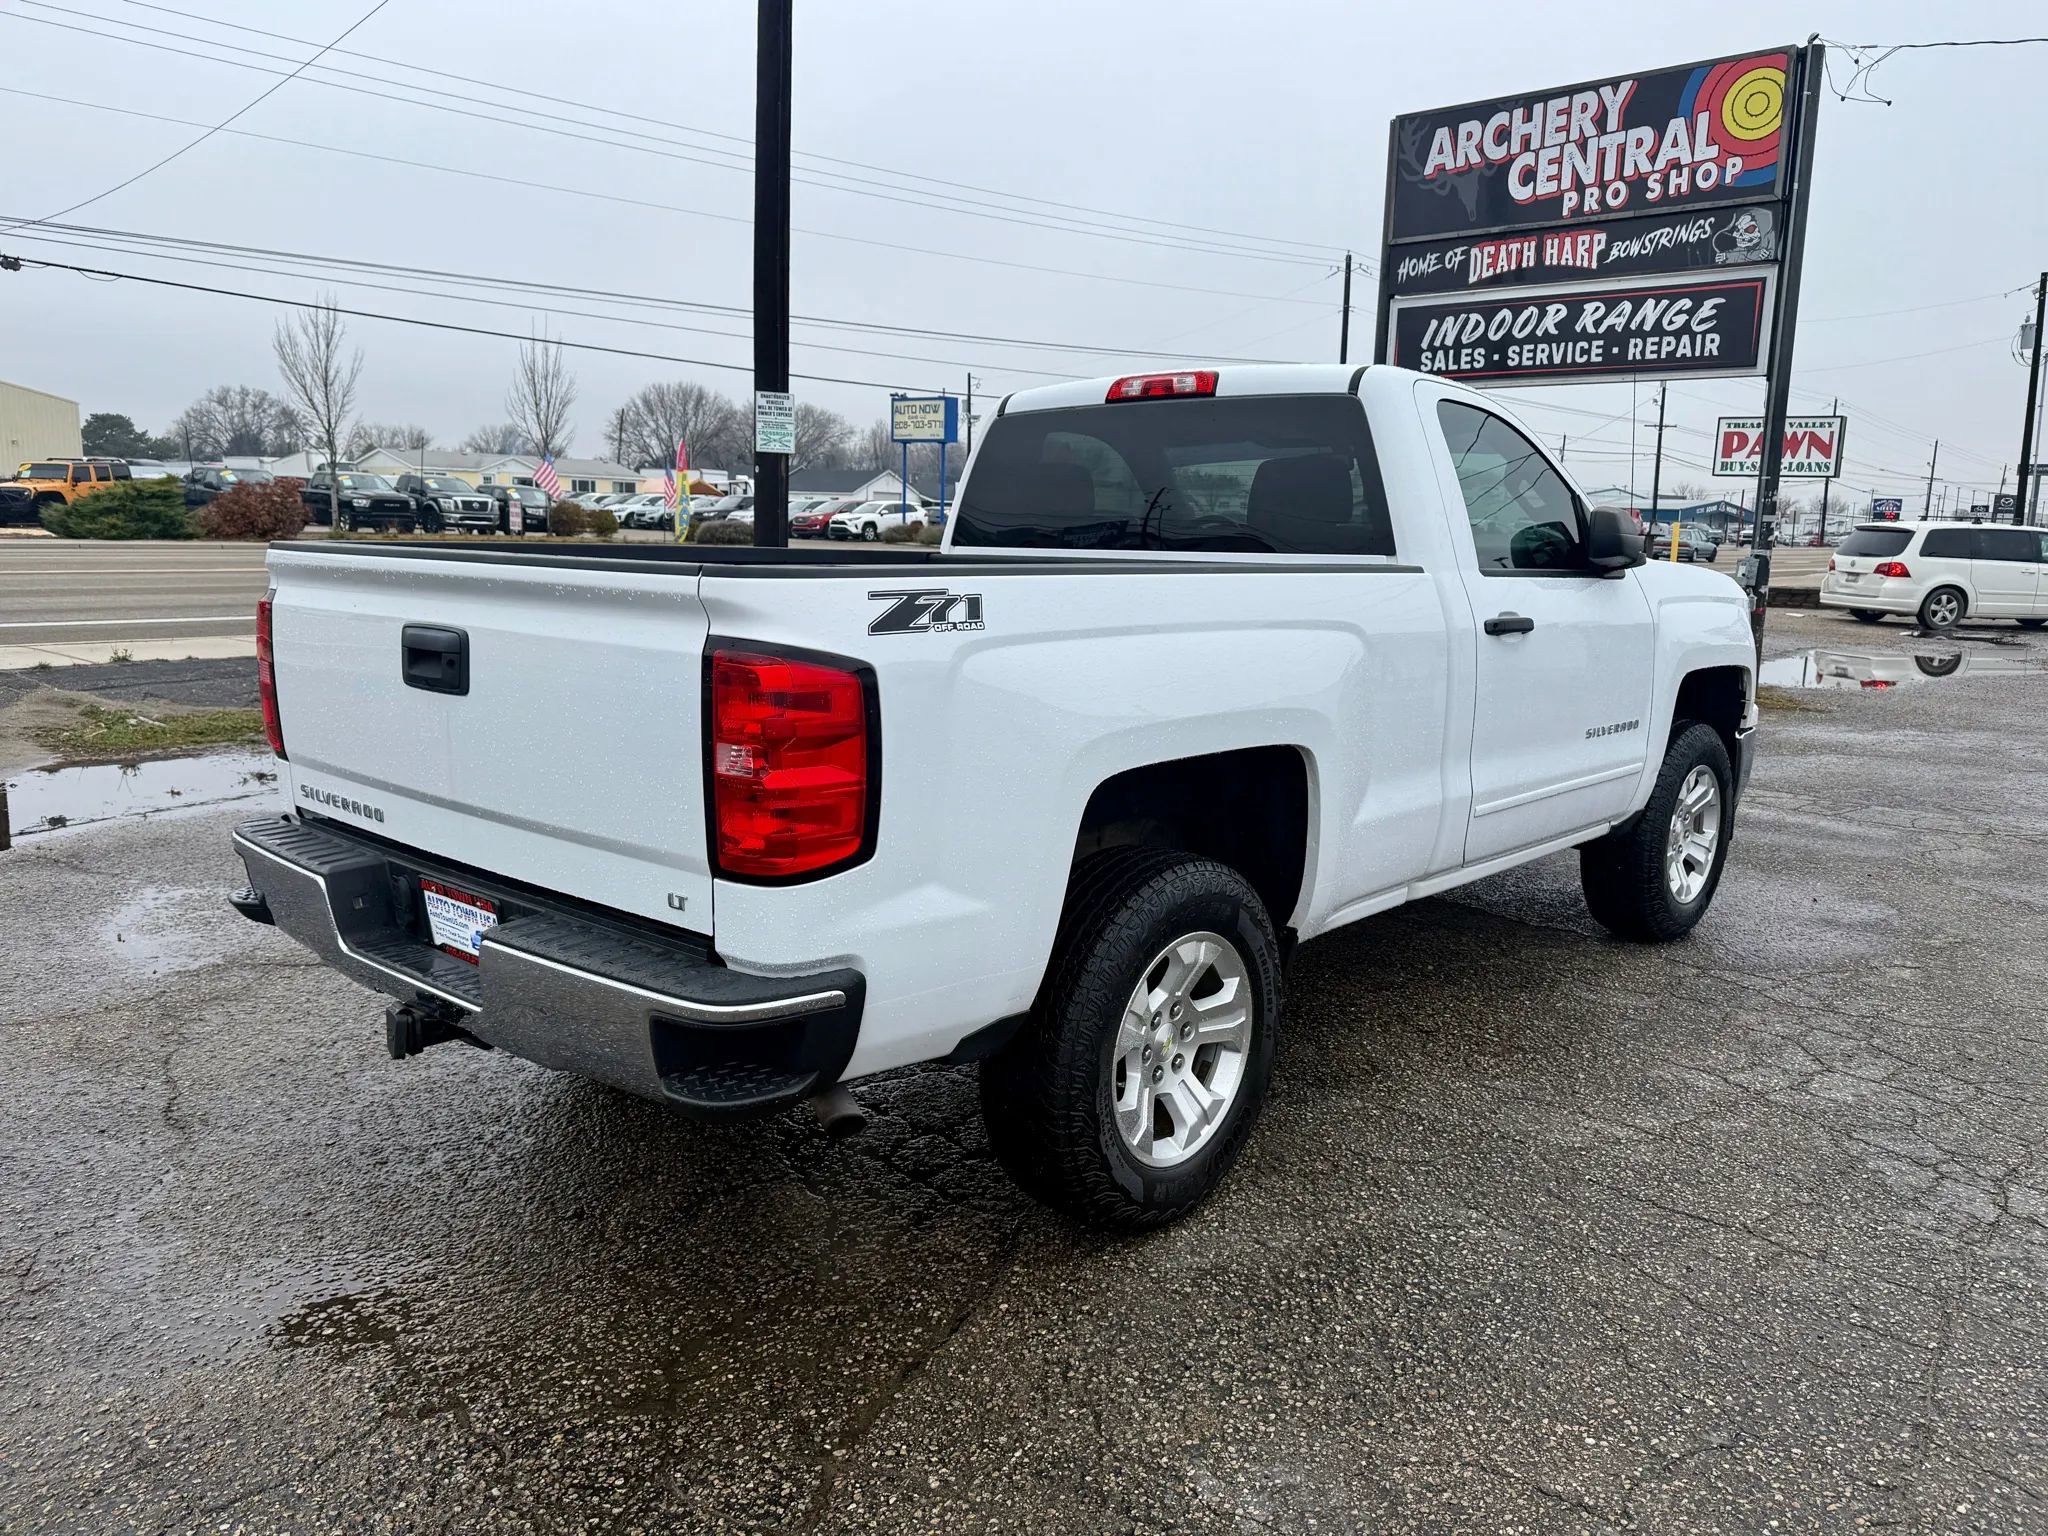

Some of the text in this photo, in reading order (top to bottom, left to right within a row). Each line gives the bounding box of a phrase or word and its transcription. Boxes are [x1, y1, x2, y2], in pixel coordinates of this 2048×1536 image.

[1424, 80, 1637, 179] ARCHERY
[1507, 111, 1720, 202] CENTRAL
[1562, 156, 1744, 217] PRO SHOP
[1397, 216, 1715, 284] HOME OF DEATH HARP BOWSTRINGS
[1420, 297, 1727, 350] INDOOR RANGE
[1420, 333, 1720, 373] SALES SERVICE REPAIR
[895, 403, 940, 415] AUTO NOW
[868, 588, 984, 636] Z71
[934, 622, 985, 632] OFF ROAD
[1585, 719, 1639, 739] SILVERADO
[300, 784, 384, 823] SILVERADO
[427, 895, 450, 914] AUTO
[451, 903, 478, 924] TOWN
[445, 887, 473, 905] TOWN
[668, 892, 688, 911] LT
[1256, 945, 1273, 1014] TERRITORY
